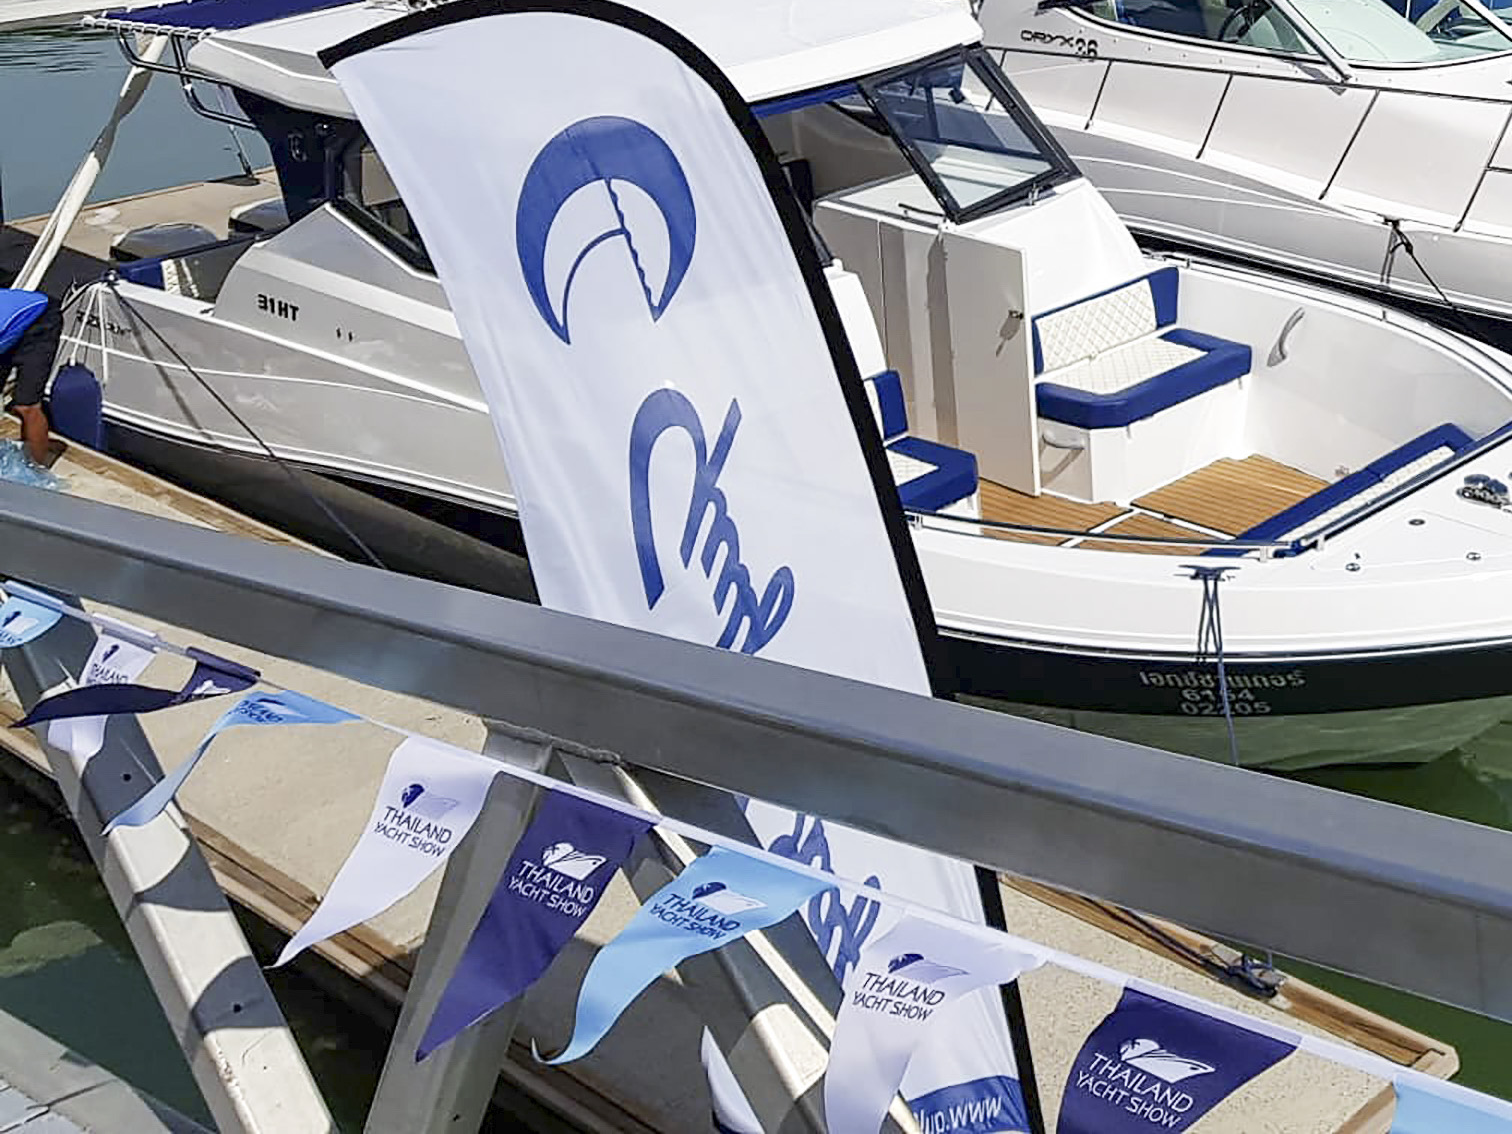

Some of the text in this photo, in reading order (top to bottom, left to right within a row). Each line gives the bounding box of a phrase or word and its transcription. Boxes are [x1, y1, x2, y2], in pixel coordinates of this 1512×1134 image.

[375, 821, 445, 858] YACHT SHOW
[384, 806, 452, 844] THAILAND
[508, 876, 587, 918] YACHT SHOW
[519, 860, 594, 904] THAILAND
[650, 903, 727, 941] YACHT SHOW
[662, 893, 741, 932] THAILAND
[852, 990, 934, 1021] YACHT SHOW
[861, 972, 946, 1006] THAILAND
[1074, 1071, 1182, 1129] YACHT SHOW
[1091, 1052, 1194, 1114] THAILAND
